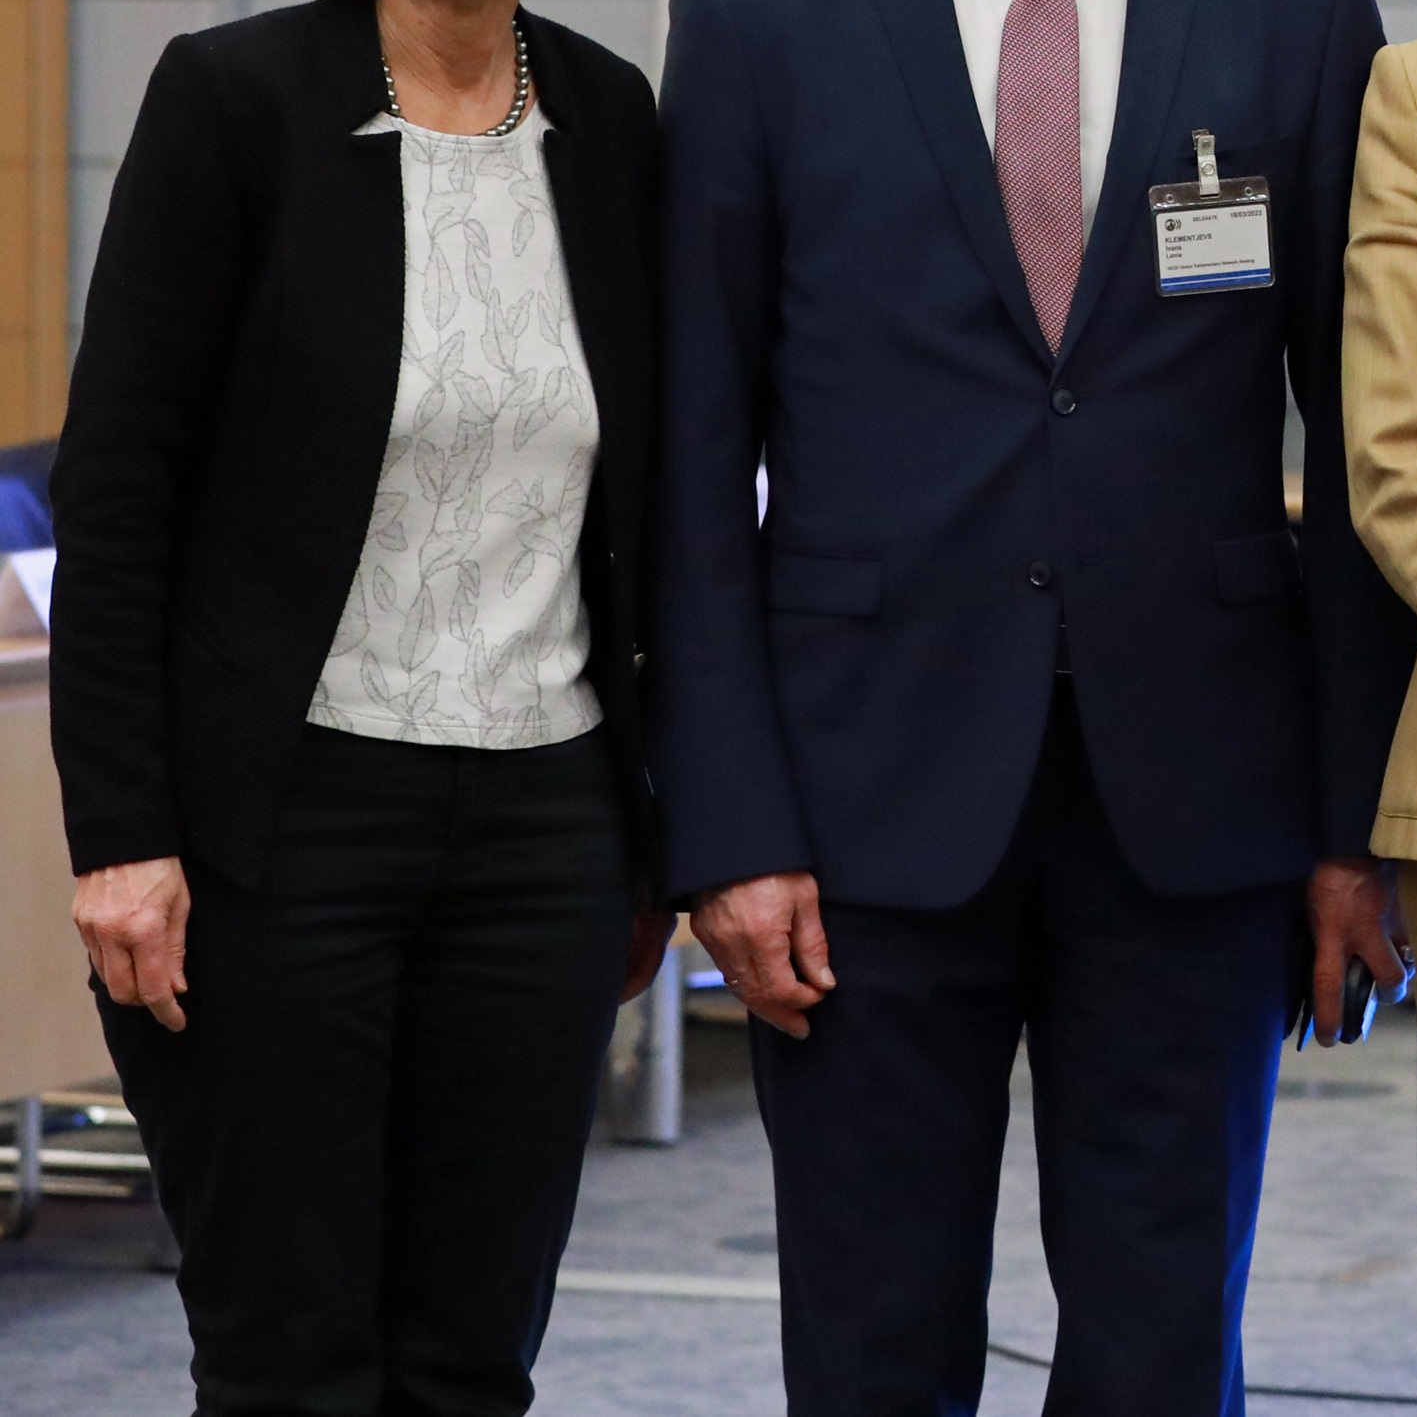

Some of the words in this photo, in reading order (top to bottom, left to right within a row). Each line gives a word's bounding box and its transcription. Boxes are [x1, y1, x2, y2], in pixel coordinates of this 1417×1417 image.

[1192, 214, 1217, 222] DELEGATE
[1230, 209, 1262, 218] 18/03/2022
[1164, 232, 1212, 243] KLEMENTJEVS
